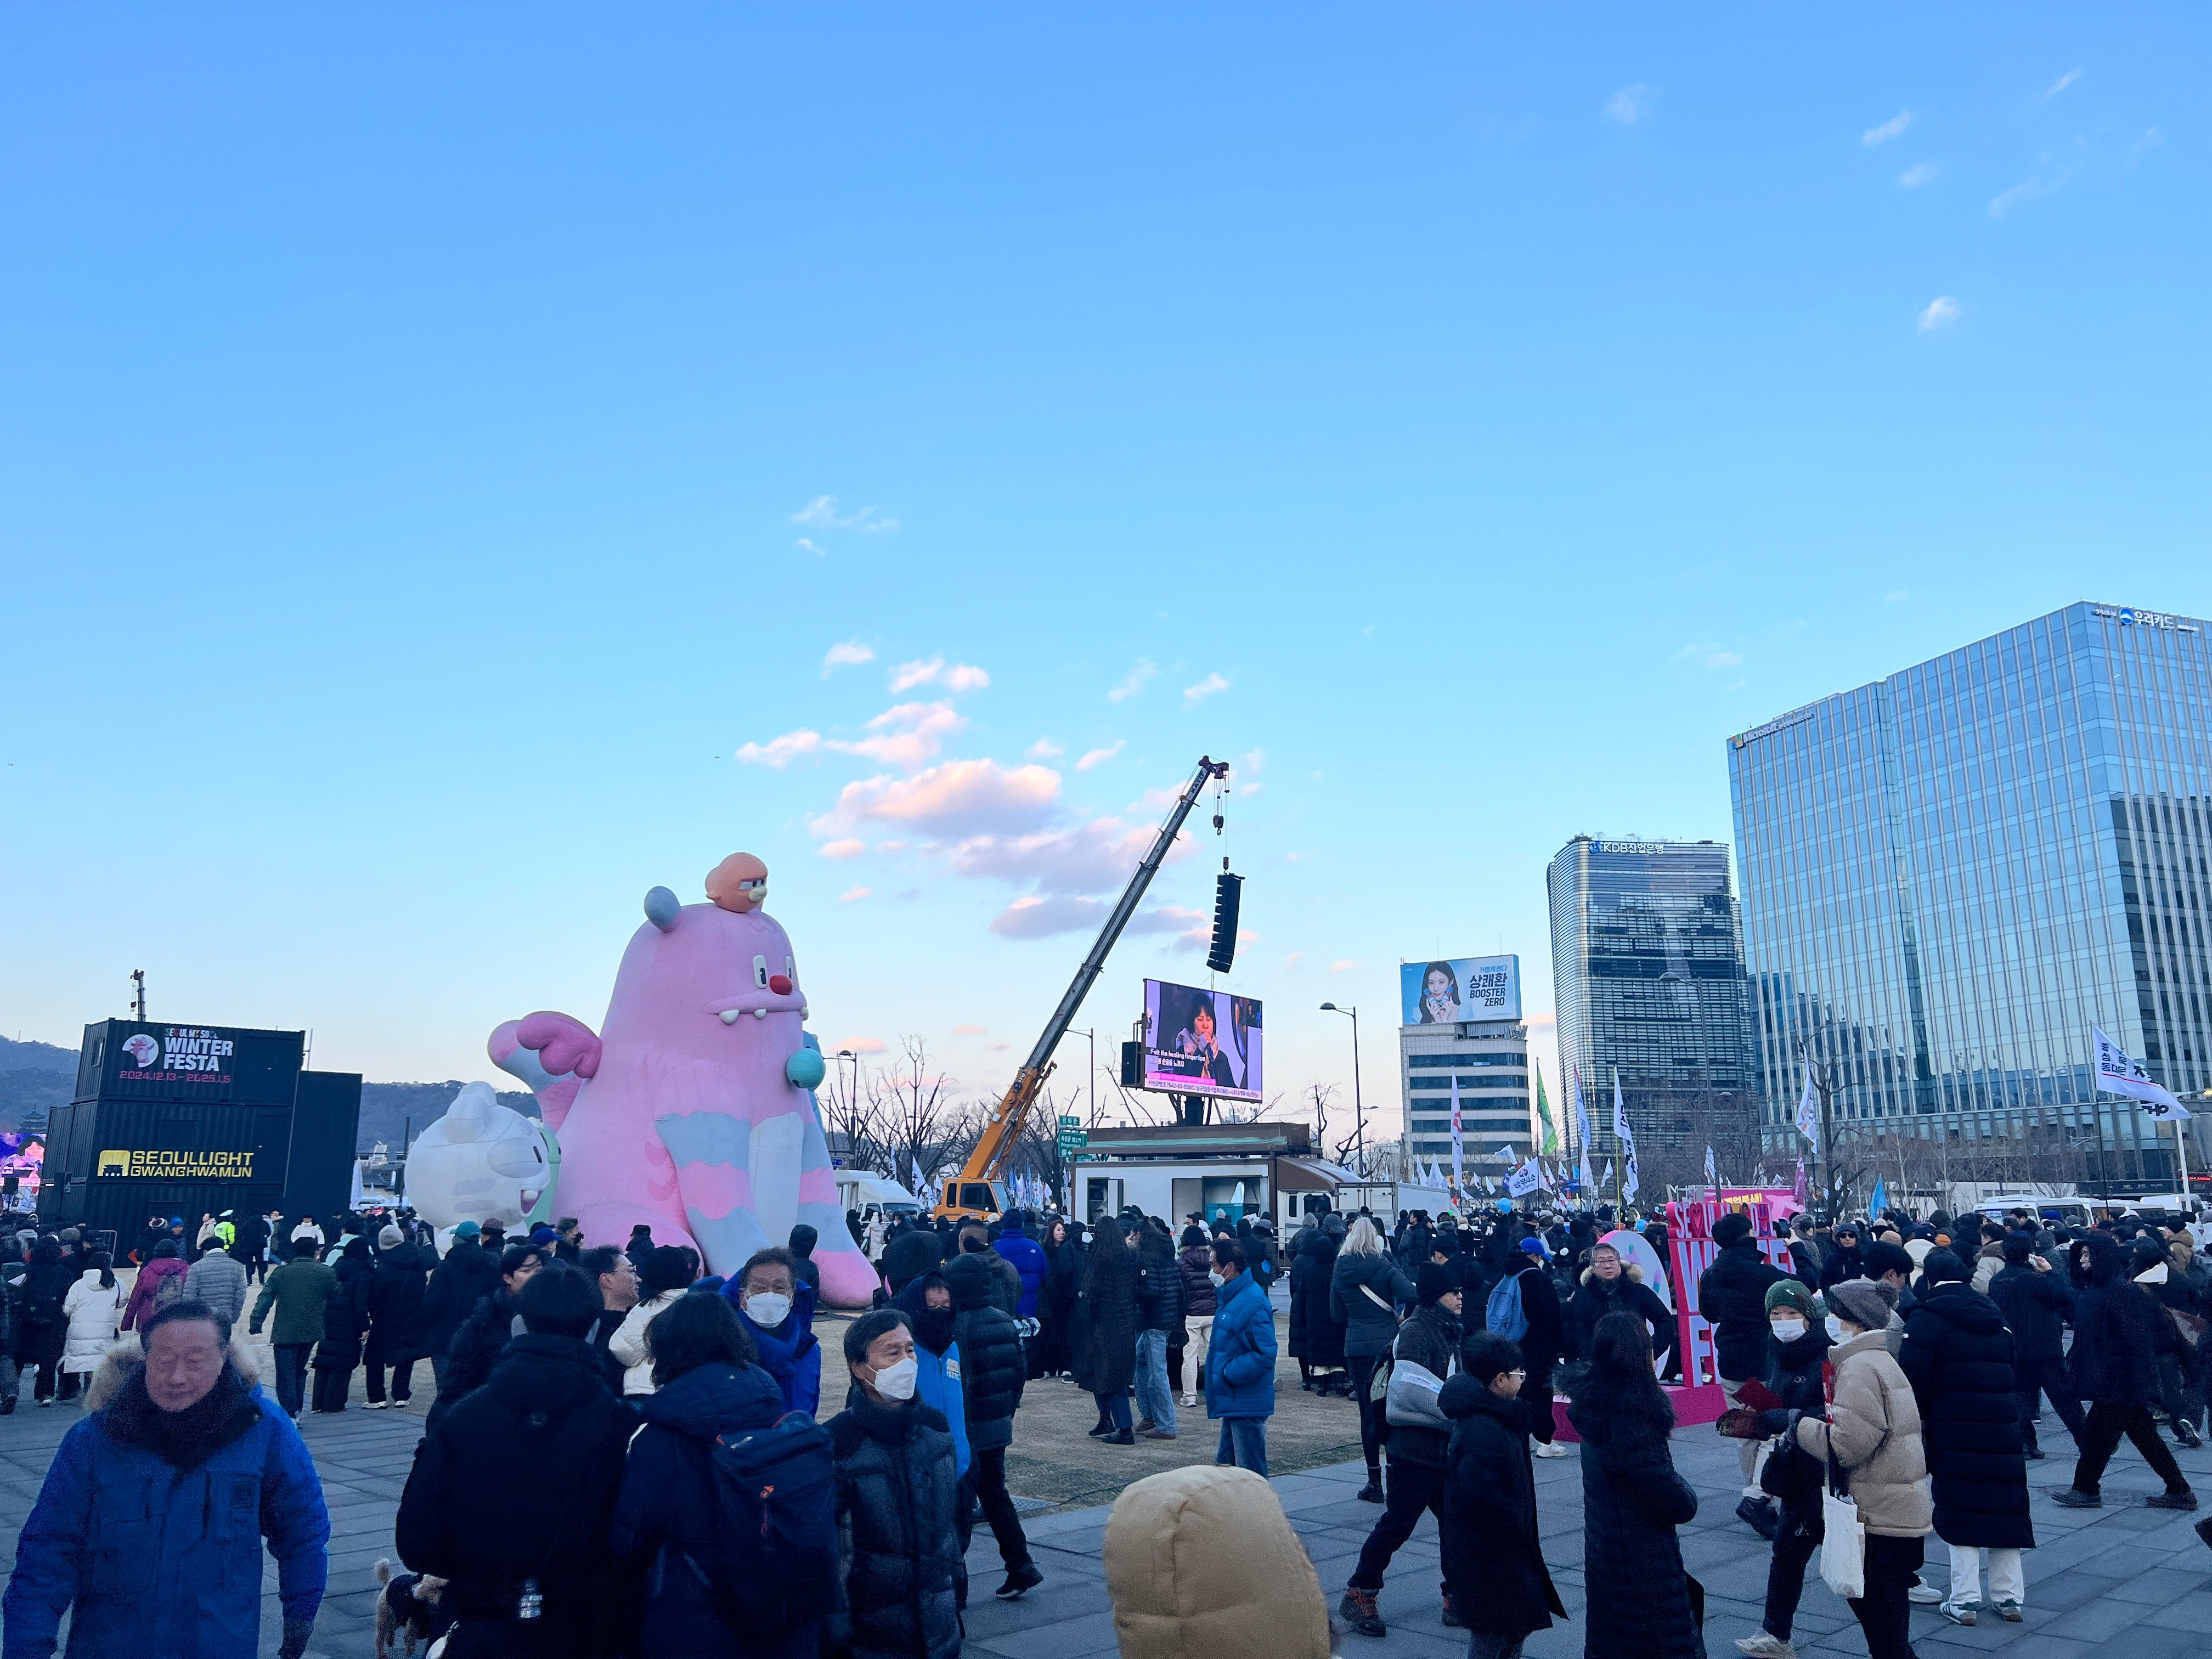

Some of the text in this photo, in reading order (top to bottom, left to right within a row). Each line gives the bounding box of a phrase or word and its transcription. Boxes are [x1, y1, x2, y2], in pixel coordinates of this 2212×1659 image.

[2134, 611, 2175, 629] 우리카드
[1743, 723, 1778, 743] Microsoft
[1469, 973, 1508, 989] 상쾌환
[1470, 988, 1506, 998] BOOSTER
[1484, 997, 1505, 1007] ZERO
[165, 1037, 234, 1056] WINTER
[163, 1054, 219, 1071] FESTA
[132, 1150, 255, 1166] SEOULLIGHT
[130, 1166, 252, 1177] GWANGHWAMUN
